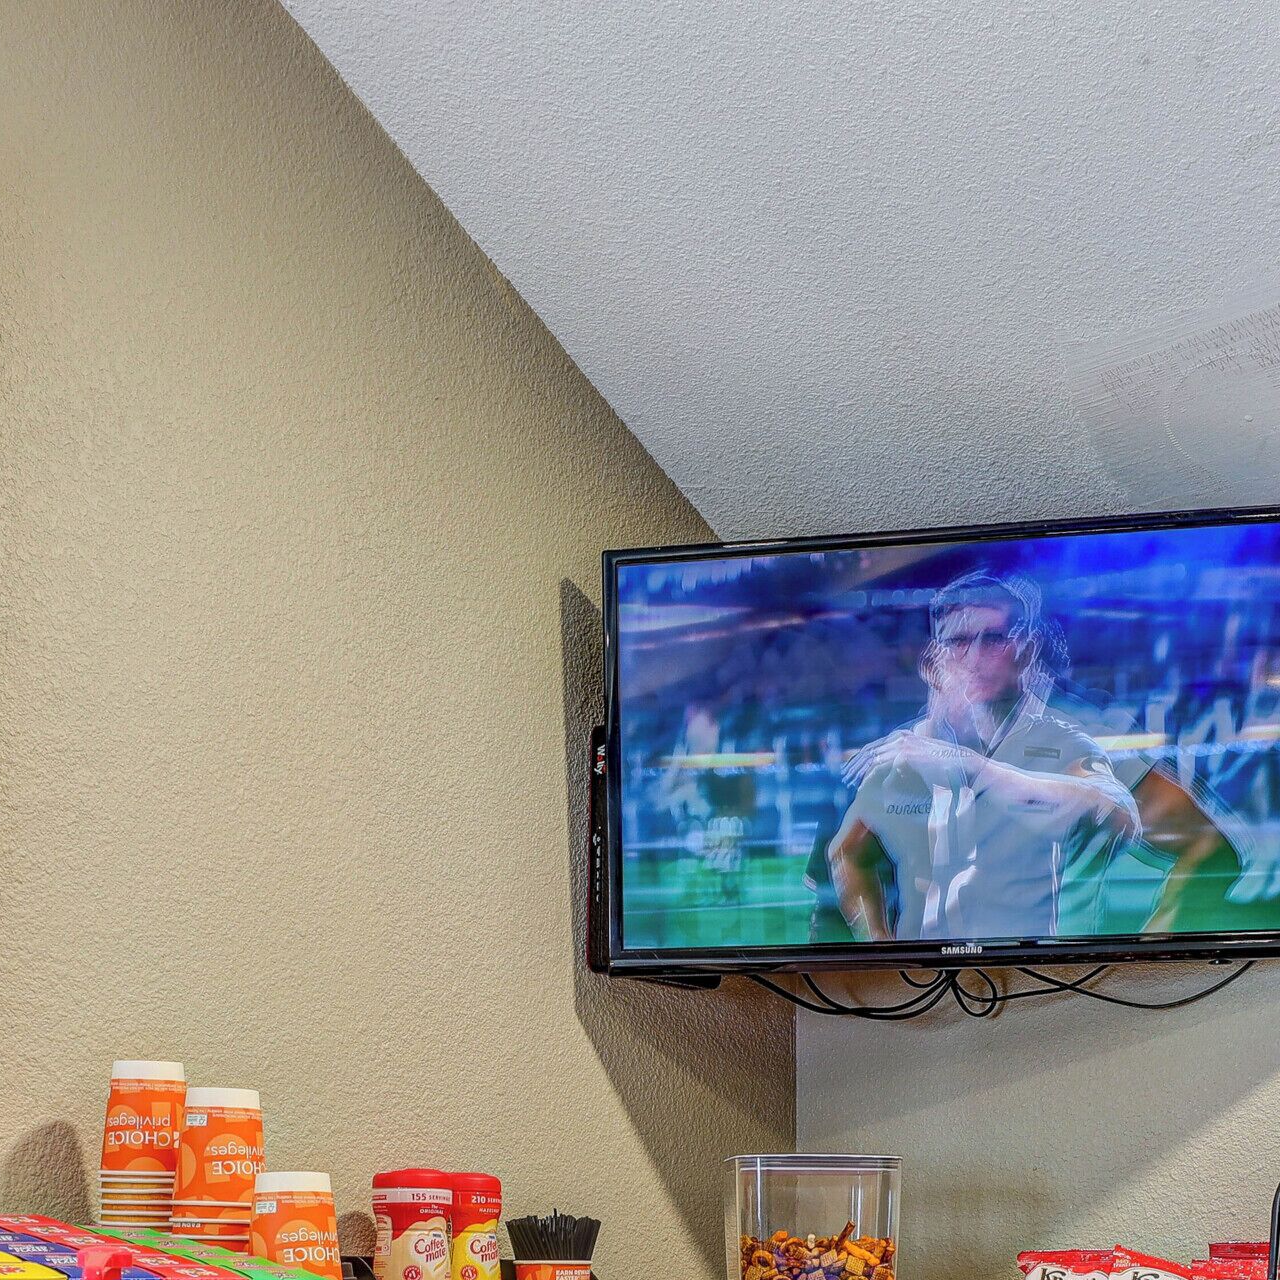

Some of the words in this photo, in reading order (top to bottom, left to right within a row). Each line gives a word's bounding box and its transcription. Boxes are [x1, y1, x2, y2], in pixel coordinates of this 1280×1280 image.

[941, 945, 984, 956] SAMSUNG
[108, 1131, 171, 1147] CHOICE
[411, 1192, 427, 1201] 155
[471, 1195, 486, 1204] 210
[414, 1238, 445, 1255] Coffee
[425, 1248, 447, 1263] mate
